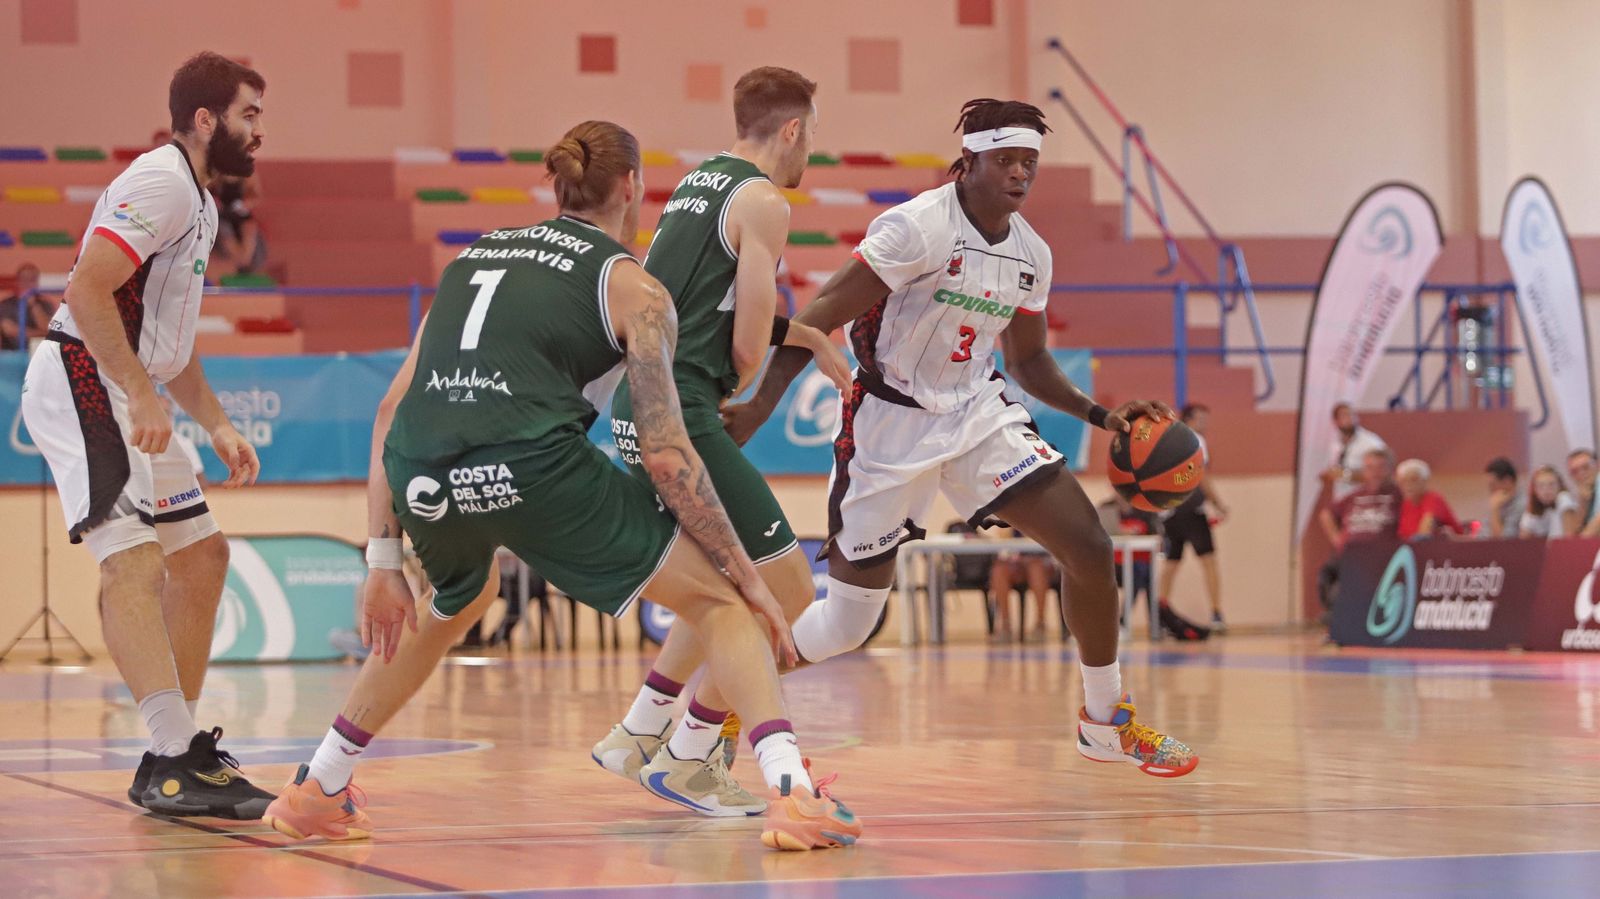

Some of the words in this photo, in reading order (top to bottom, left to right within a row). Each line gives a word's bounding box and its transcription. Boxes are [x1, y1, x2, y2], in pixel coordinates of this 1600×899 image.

[461, 268, 507, 350] 1
[950, 325, 976, 363] 3
[425, 367, 512, 396] Andalucía
[449, 463, 514, 486] COSTA
[1000, 454, 1039, 482] BERNER
[452, 487, 482, 501] DEL
[482, 481, 518, 498] SOL
[457, 495, 523, 514] MÁLAGA
